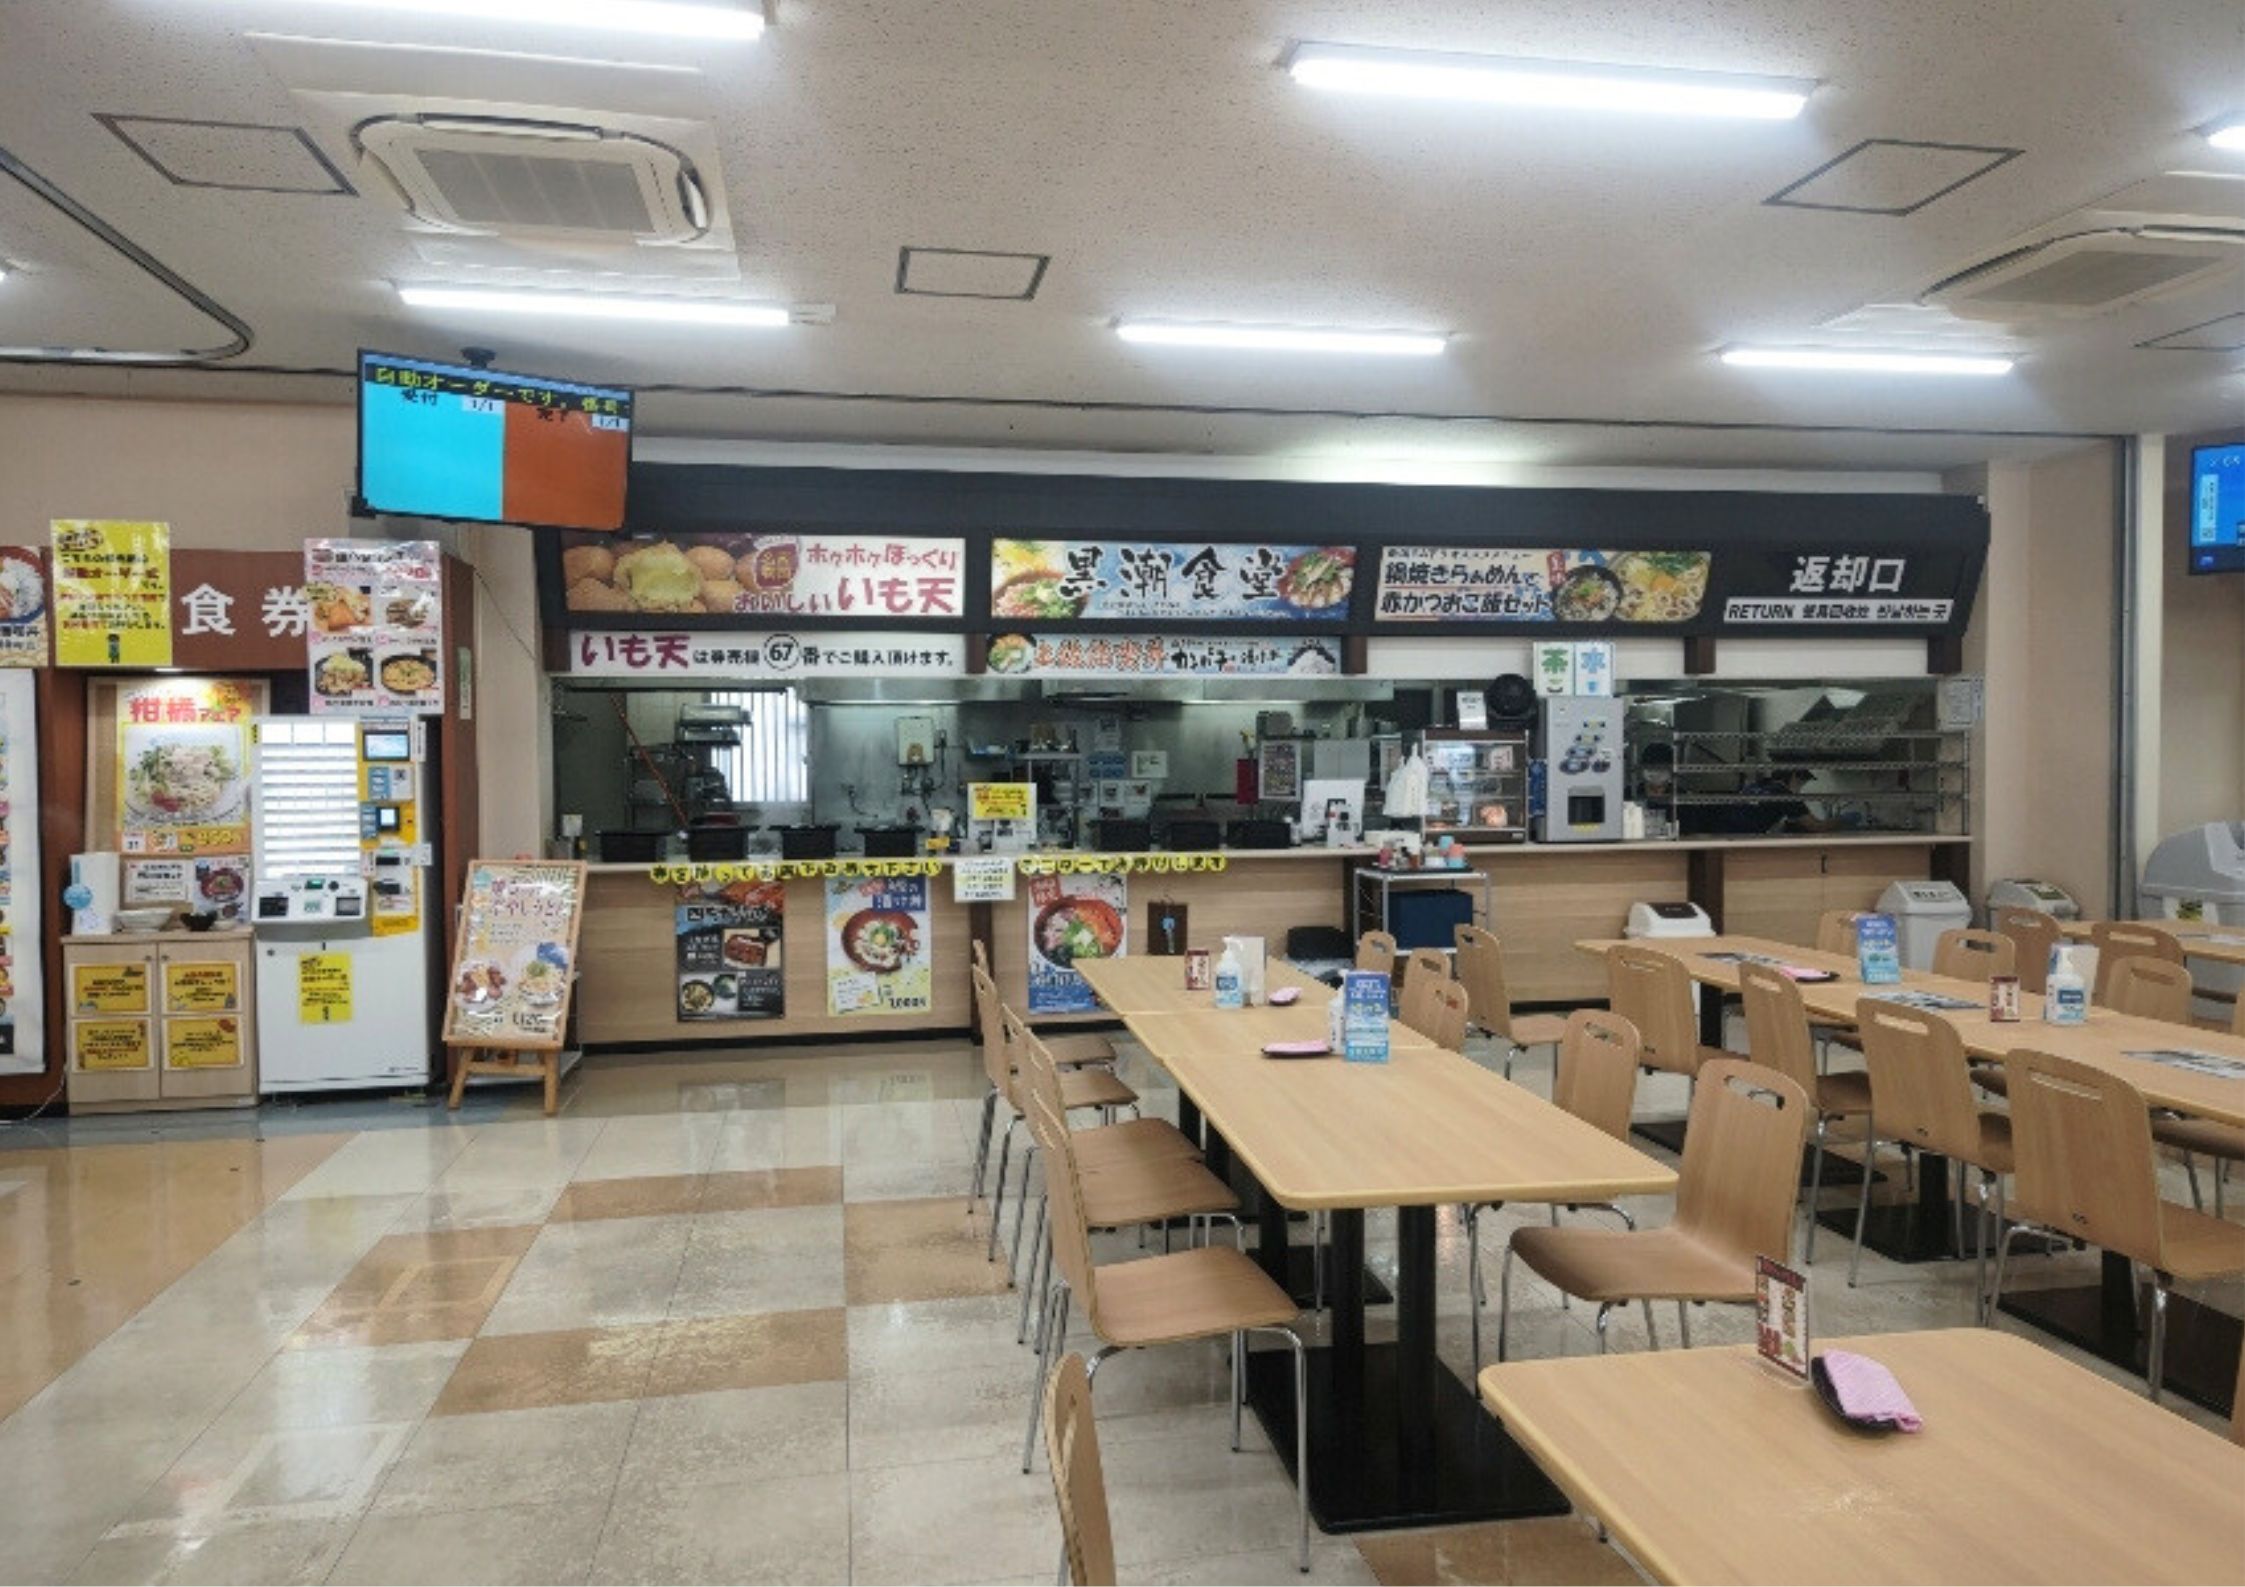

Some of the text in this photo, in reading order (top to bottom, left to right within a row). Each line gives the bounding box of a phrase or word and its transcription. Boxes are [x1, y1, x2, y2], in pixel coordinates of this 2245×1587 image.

[1058, 545, 1287, 600] 黒潮食堂
[1789, 554, 1906, 593] 返却口
[180, 583, 309, 638] 食券
[838, 577, 957, 614] いも天
[1728, 604, 1794, 619] RETURN
[1541, 646, 1569, 674] 茶
[1580, 646, 1606, 674] 水
